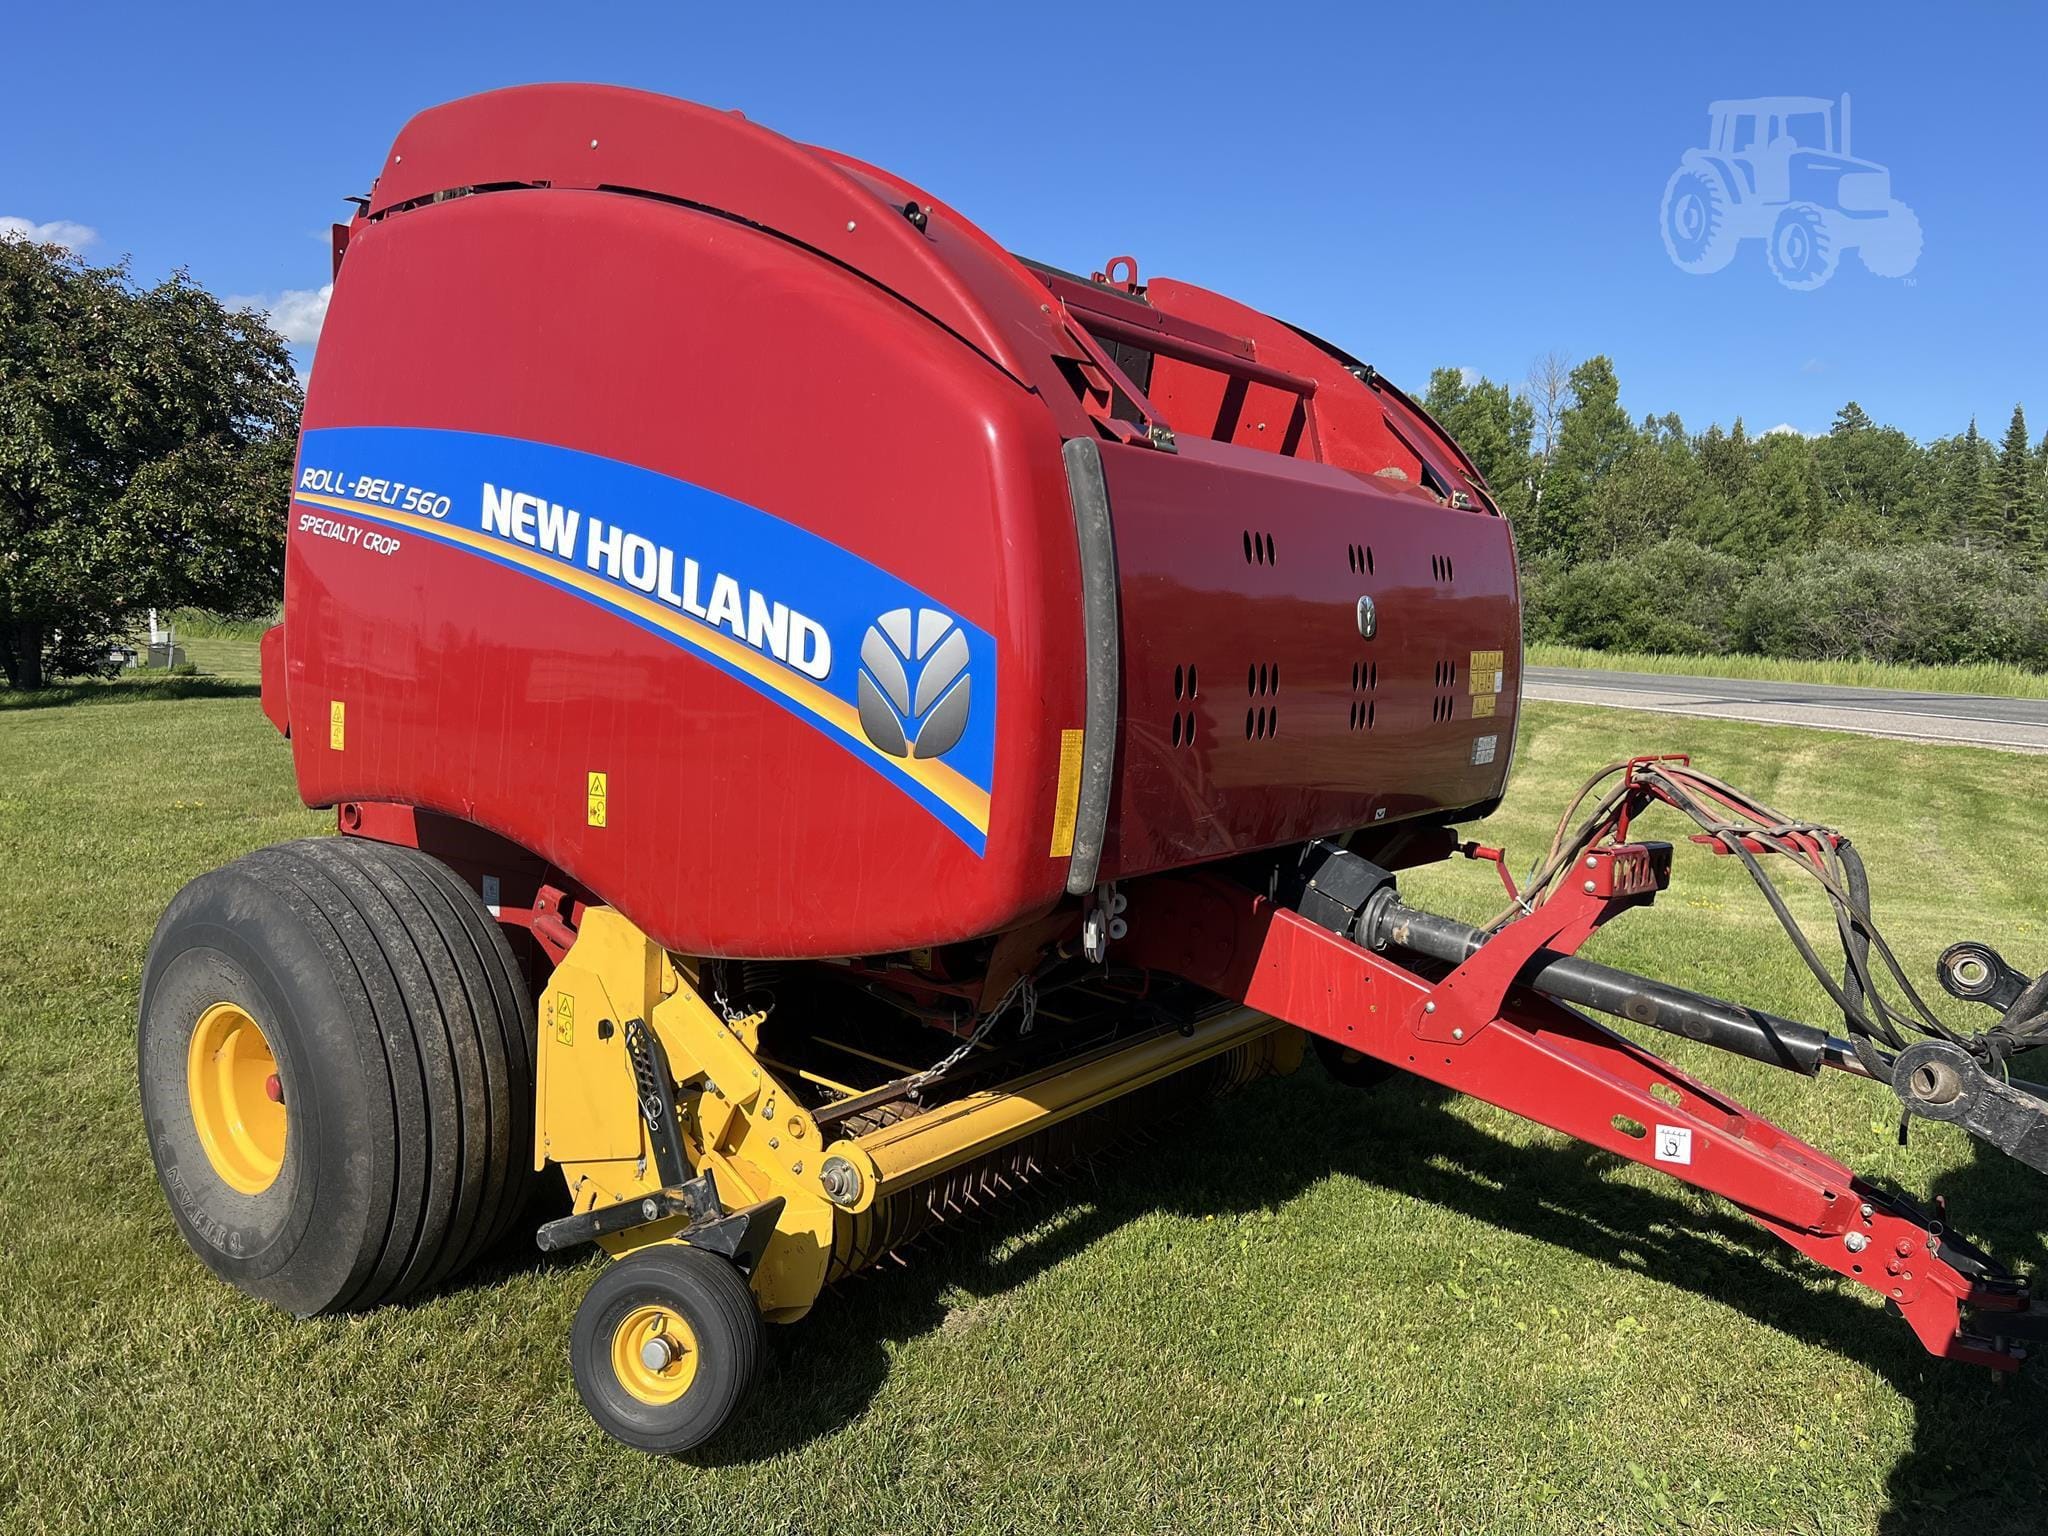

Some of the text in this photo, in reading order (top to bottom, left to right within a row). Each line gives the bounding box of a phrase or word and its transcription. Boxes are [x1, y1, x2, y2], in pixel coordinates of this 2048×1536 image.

[401, 486, 451, 519] 560
[298, 514, 401, 556] SPECIALTY CROP
[481, 482, 832, 680] NEW HOLLAND
